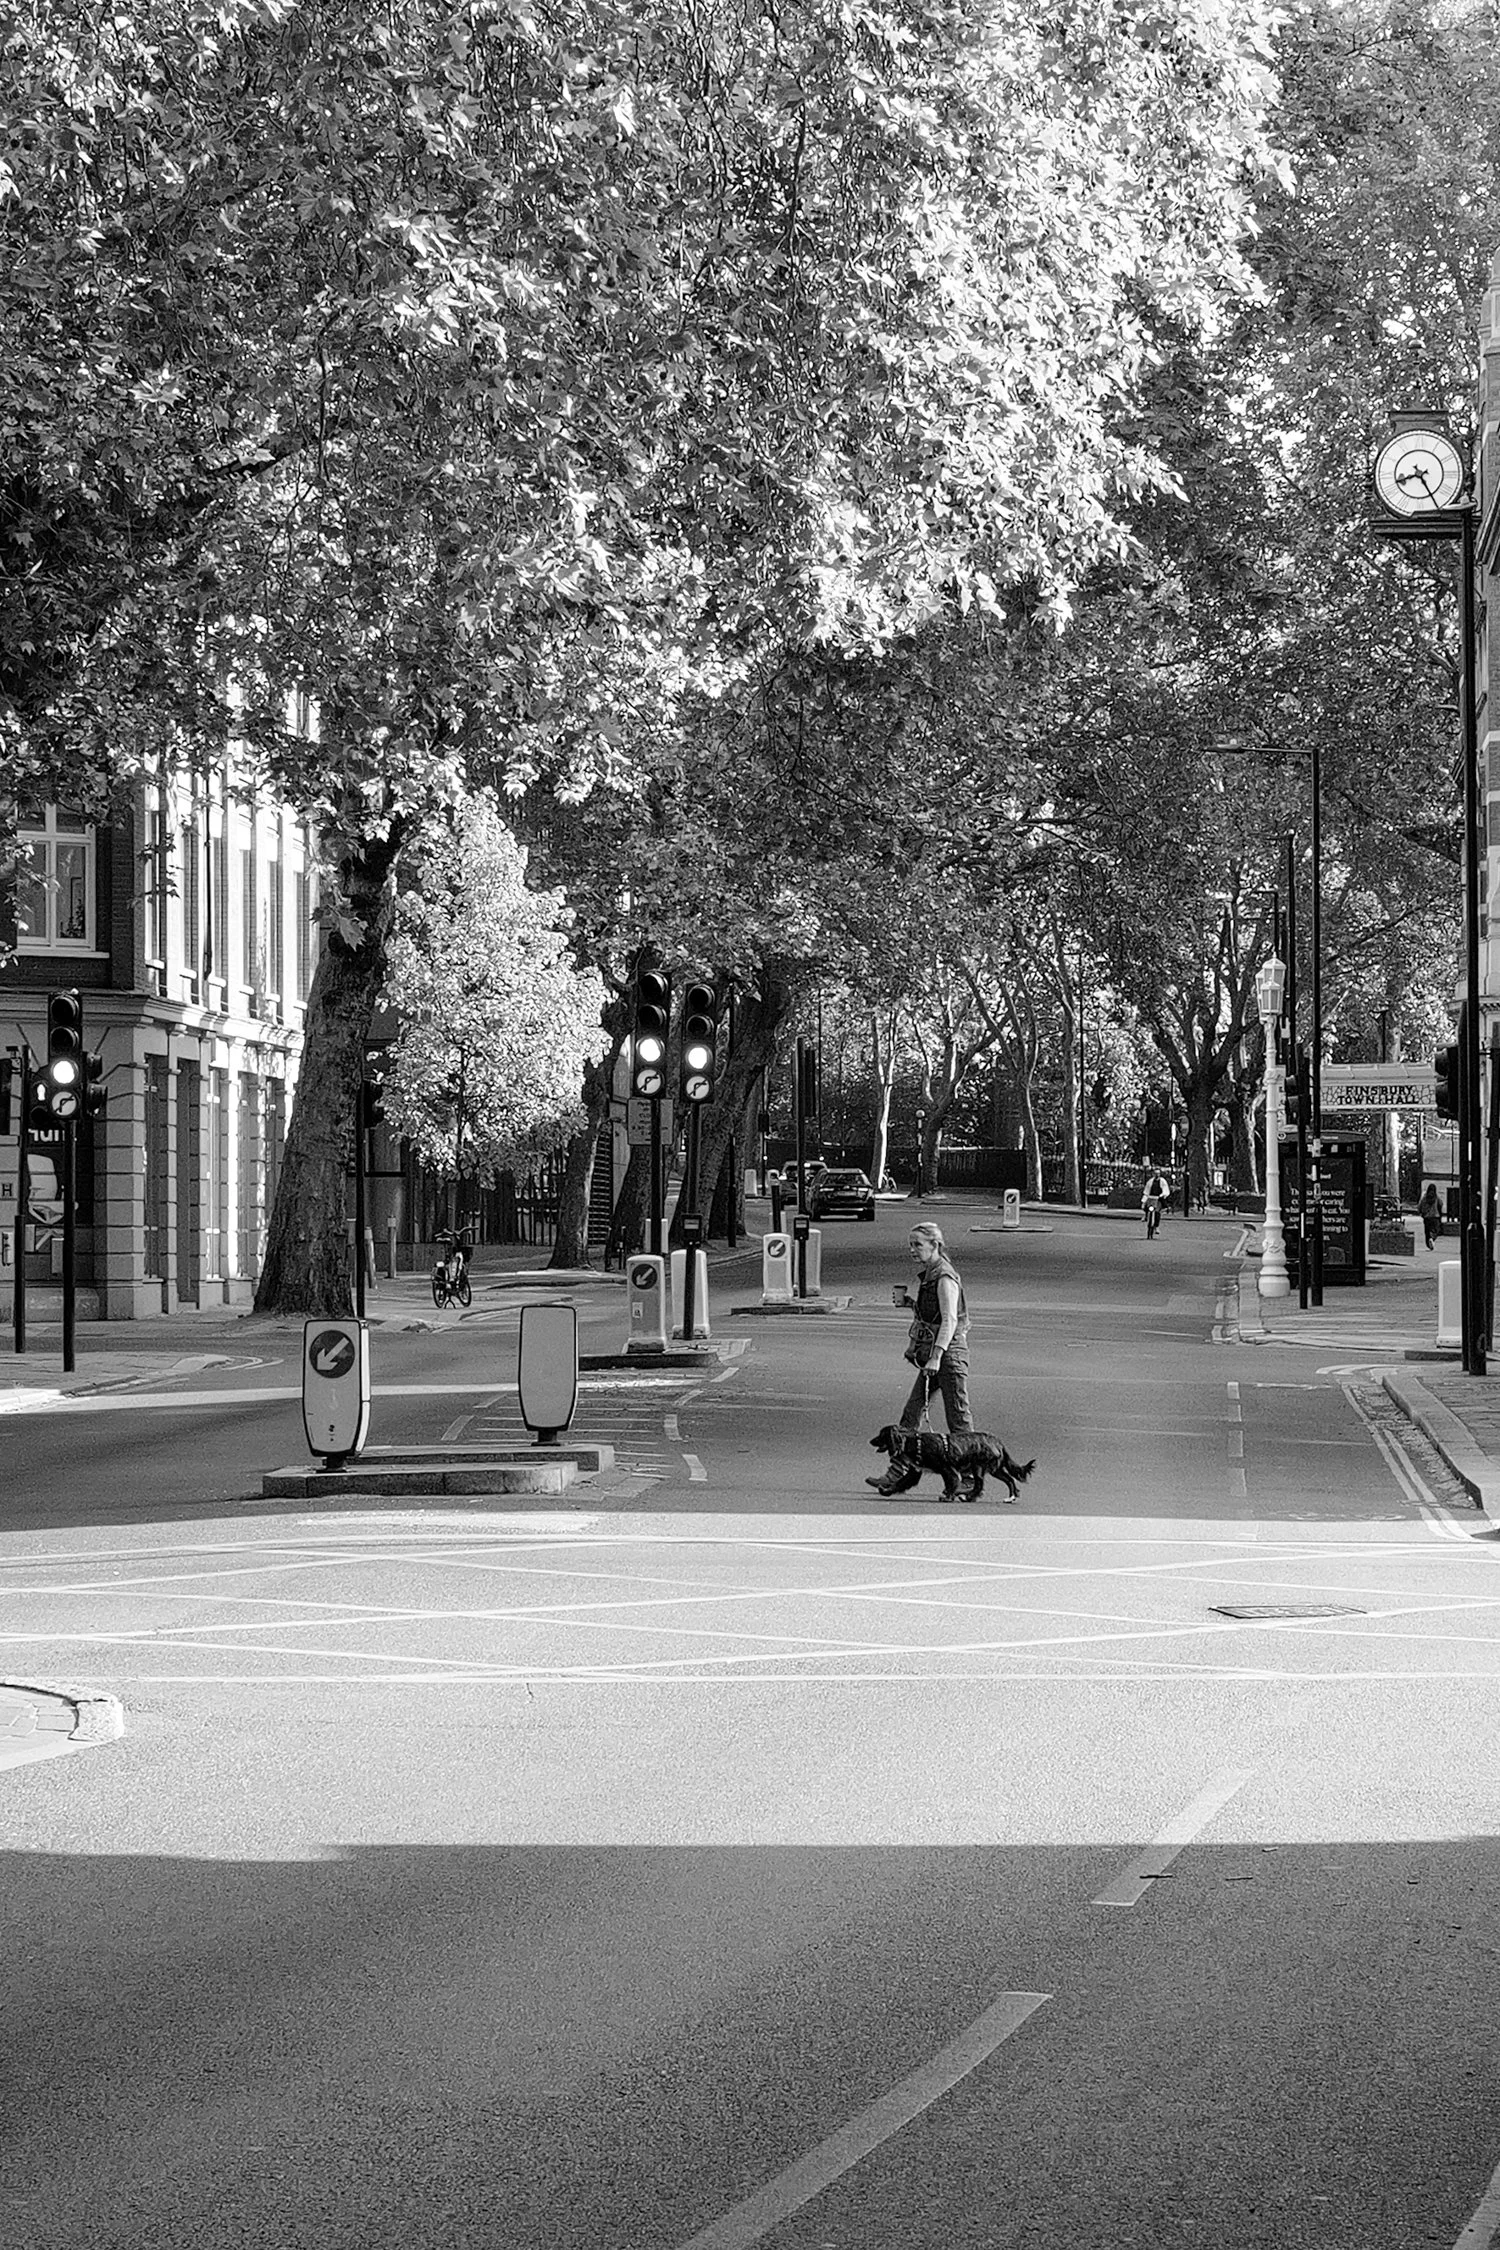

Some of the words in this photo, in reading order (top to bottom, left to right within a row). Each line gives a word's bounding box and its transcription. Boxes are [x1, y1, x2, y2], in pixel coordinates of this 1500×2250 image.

[1346, 1086, 1413, 1095] FINSBURY
[1338, 1096, 1375, 1105] TOWN
[1385, 1096, 1419, 1104] HALL
